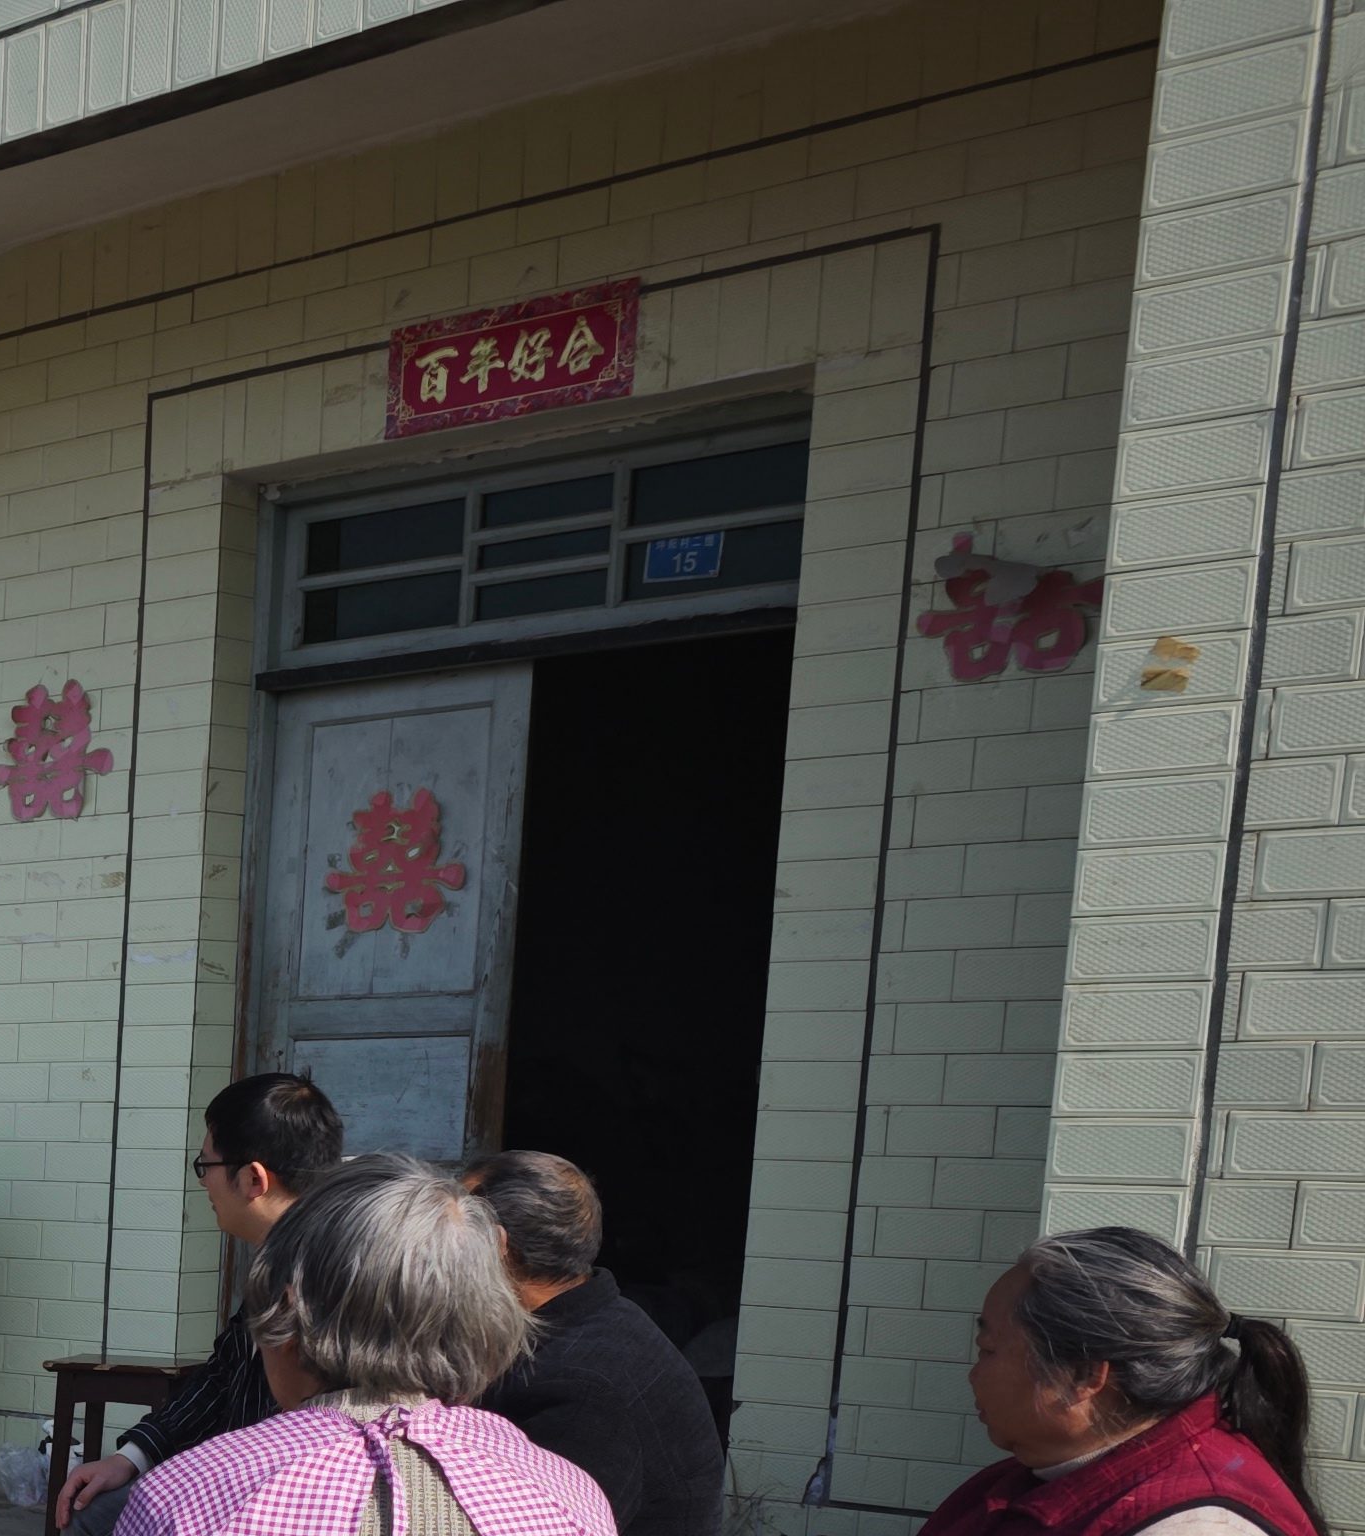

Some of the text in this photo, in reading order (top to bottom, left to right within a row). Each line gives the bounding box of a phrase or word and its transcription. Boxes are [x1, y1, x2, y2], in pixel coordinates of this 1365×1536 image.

[415, 315, 604, 404] 百年好合
[672, 551, 698, 573] 15
